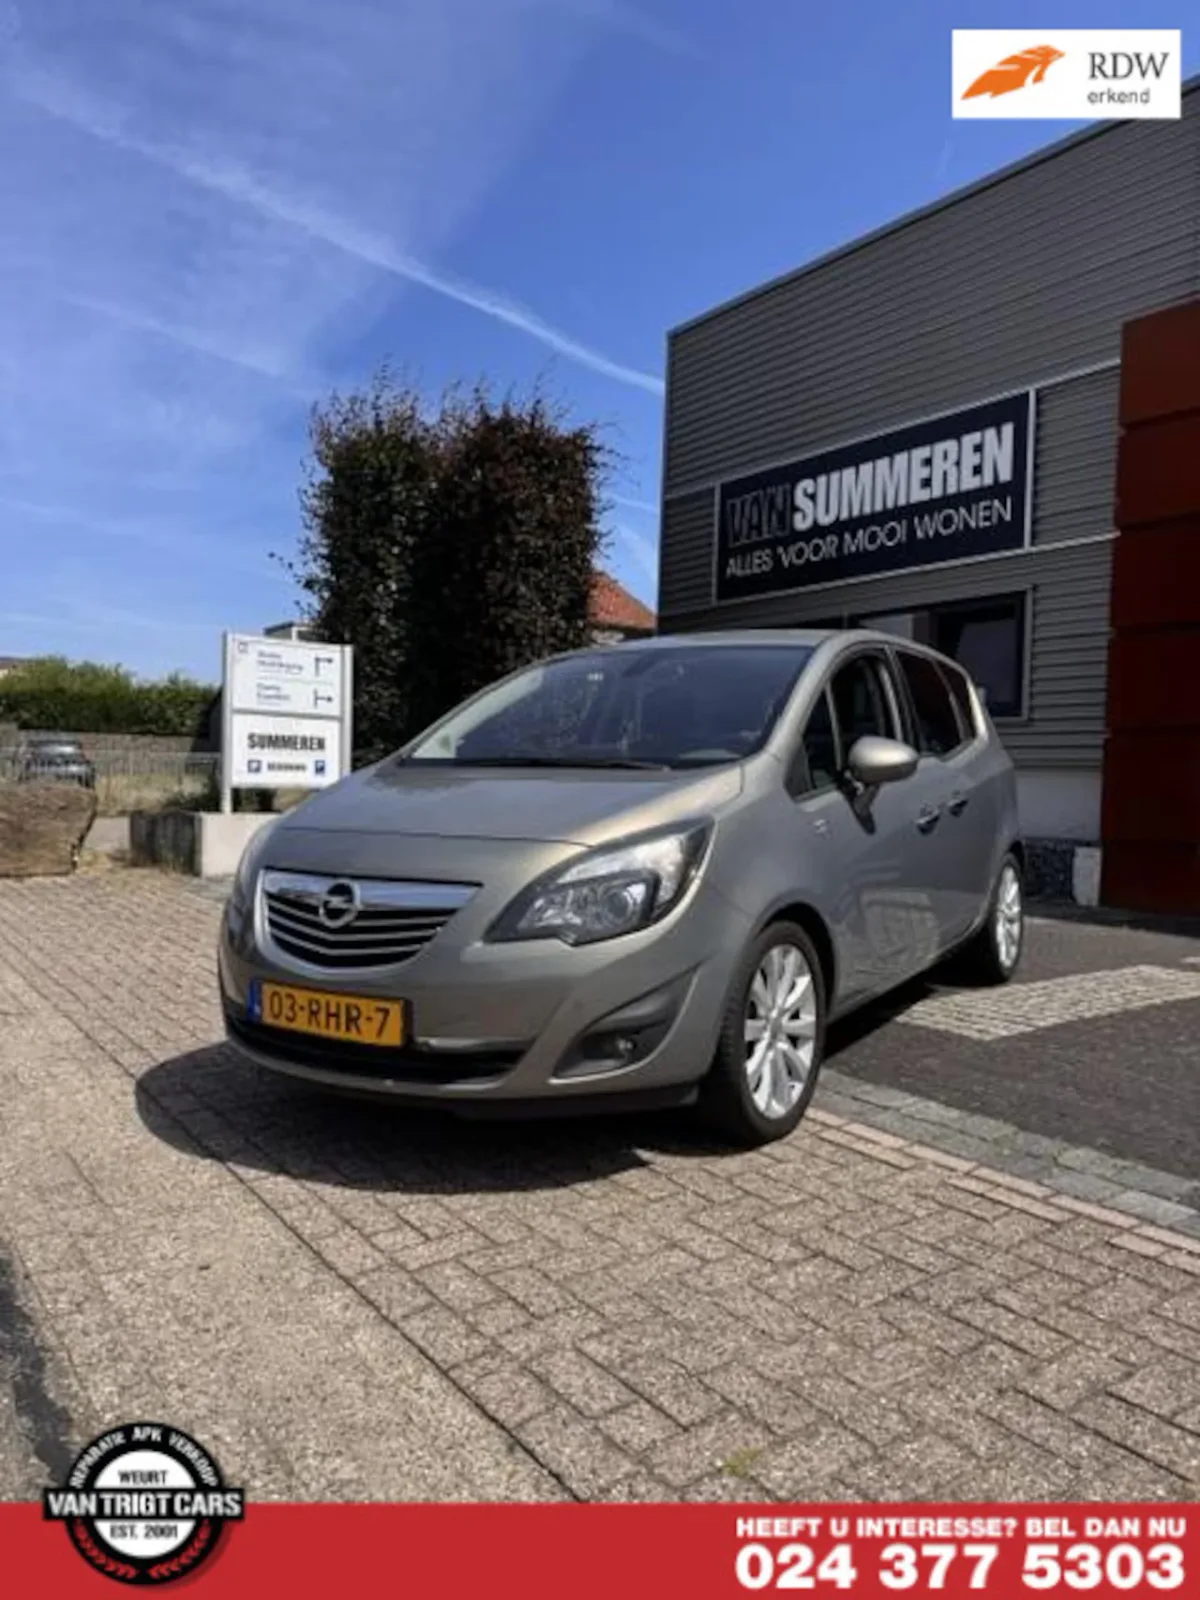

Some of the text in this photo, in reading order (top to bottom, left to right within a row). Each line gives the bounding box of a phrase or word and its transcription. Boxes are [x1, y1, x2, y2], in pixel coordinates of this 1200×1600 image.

[793, 422, 1014, 532] SUMMEREN
[726, 495, 1012, 578] ALLES VOOR MOOI WONEN
[247, 732, 326, 751] SUMMEREN
[268, 990, 391, 1039] 03-RHR-7
